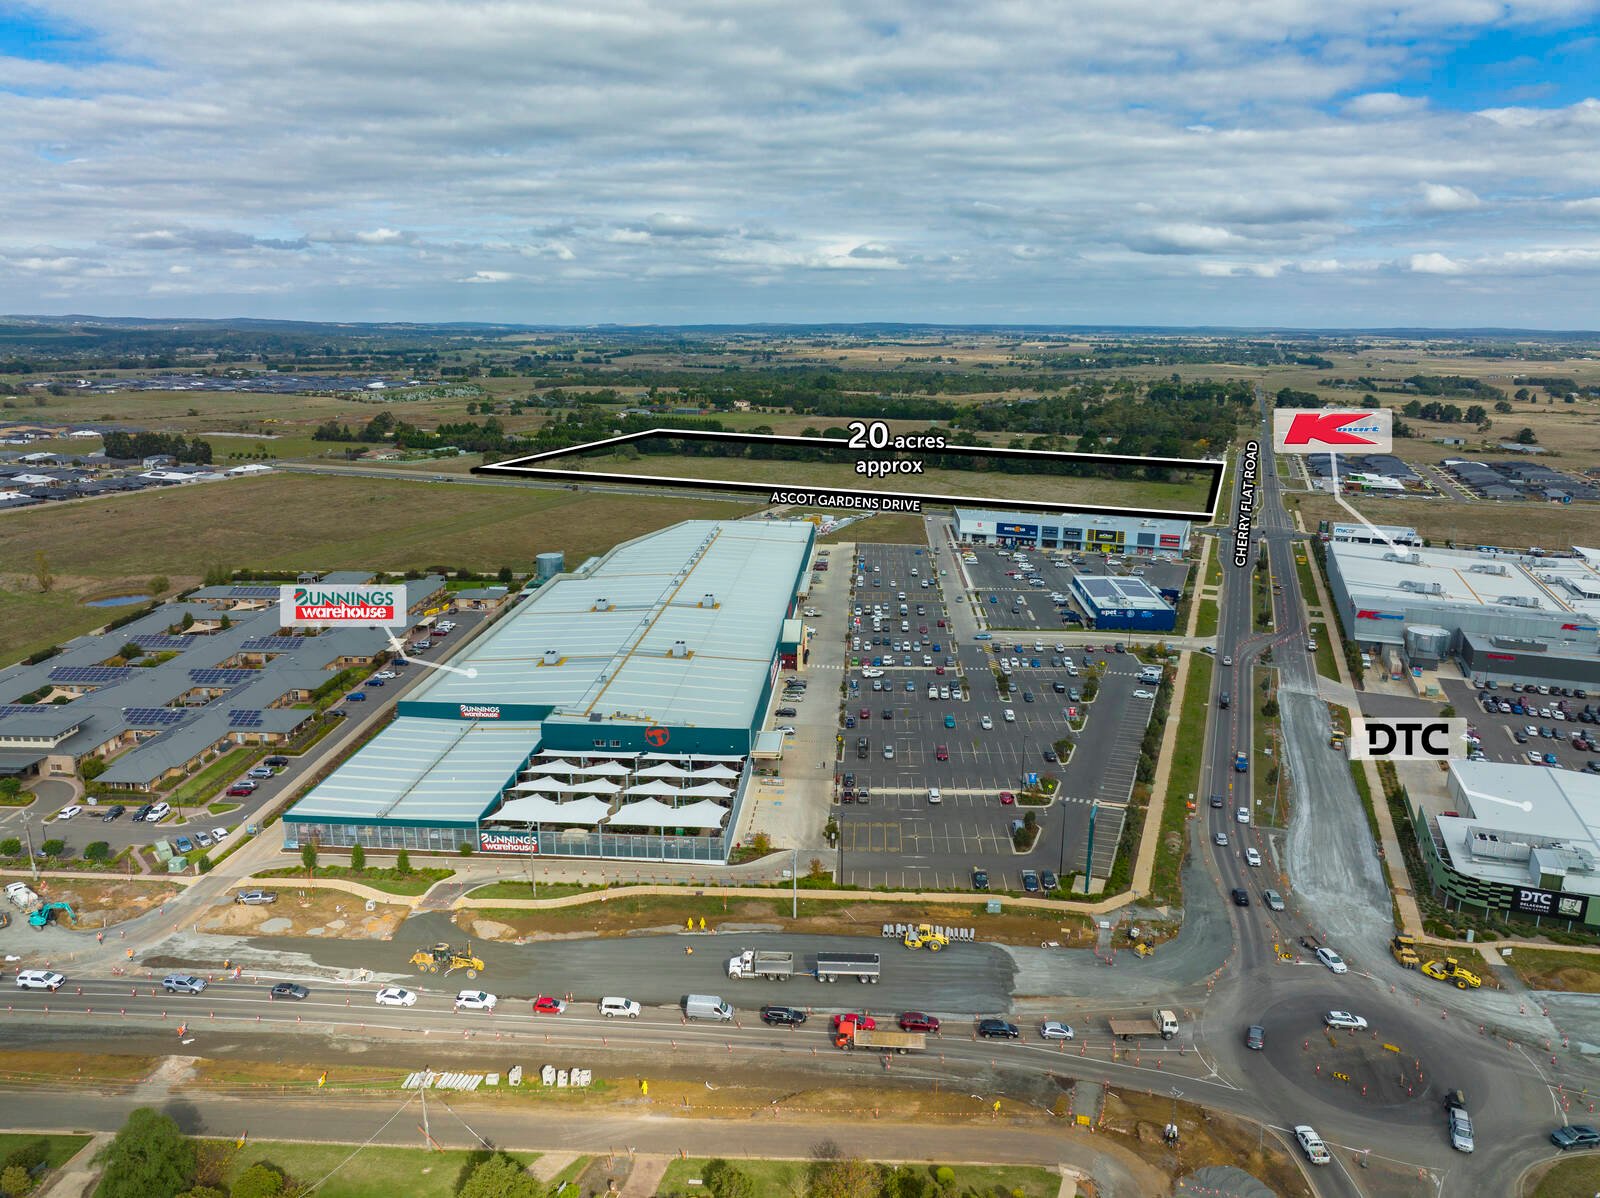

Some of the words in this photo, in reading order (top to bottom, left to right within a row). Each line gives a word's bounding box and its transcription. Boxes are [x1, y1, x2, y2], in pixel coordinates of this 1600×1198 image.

[460, 704, 500, 713] BUNNINGS
[480, 832, 538, 845] BUNNINGS
[1520, 890, 1552, 904] DTC
